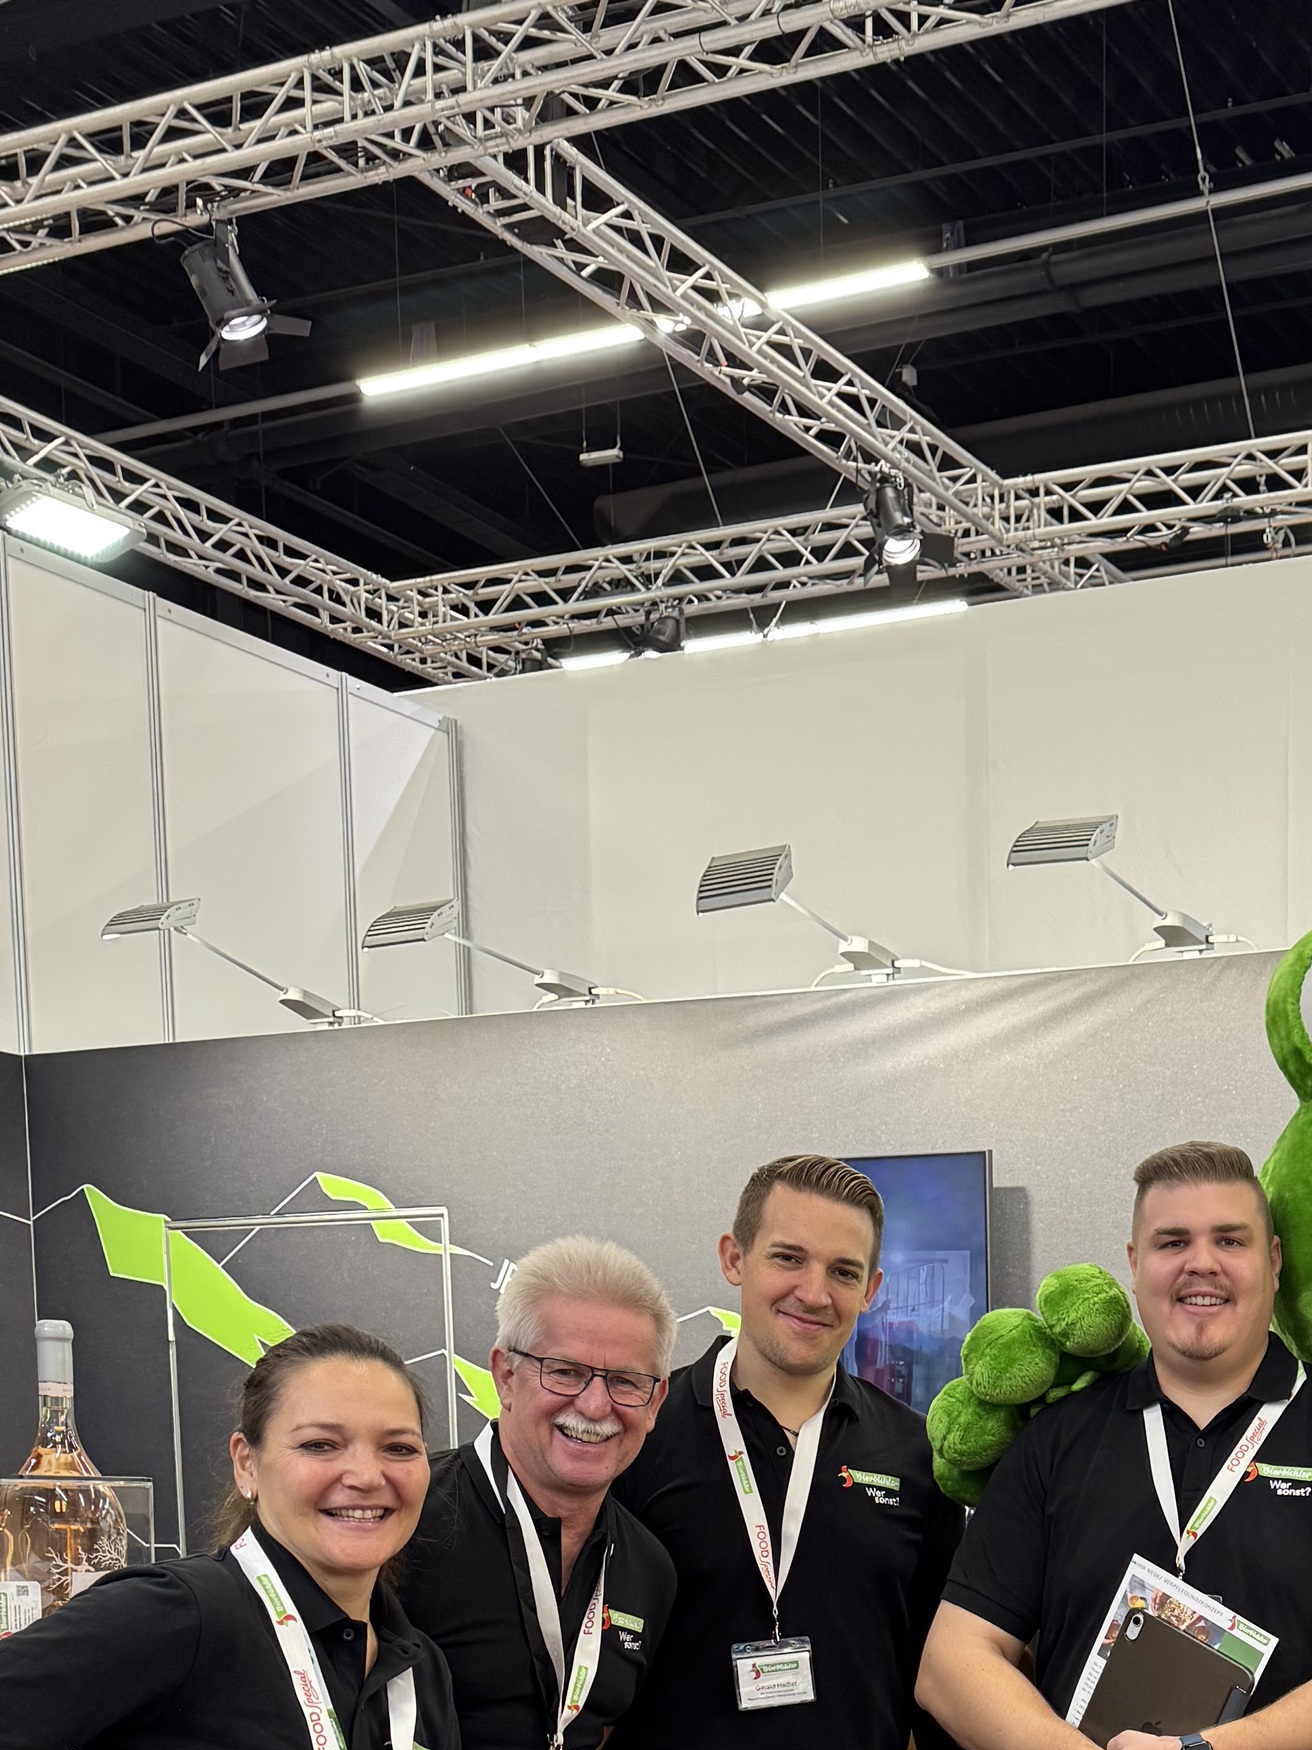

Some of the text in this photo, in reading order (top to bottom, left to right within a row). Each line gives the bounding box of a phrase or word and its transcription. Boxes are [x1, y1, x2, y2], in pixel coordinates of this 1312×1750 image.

[719, 1362, 728, 1389] FOOD
[1227, 1417, 1268, 1472] FOOD Special
[1262, 1466, 1312, 1479] Bierbichler
[1269, 1480, 1292, 1489] Wer
[866, 1487, 886, 1498] Wer
[1276, 1487, 1312, 1496] sonst?
[875, 1496, 900, 1506] sonst?
[756, 1524, 770, 1558] FOOD
[583, 1602, 597, 1635] FOOD
[618, 1631, 634, 1641] Wer
[294, 1669, 322, 1713] Special
